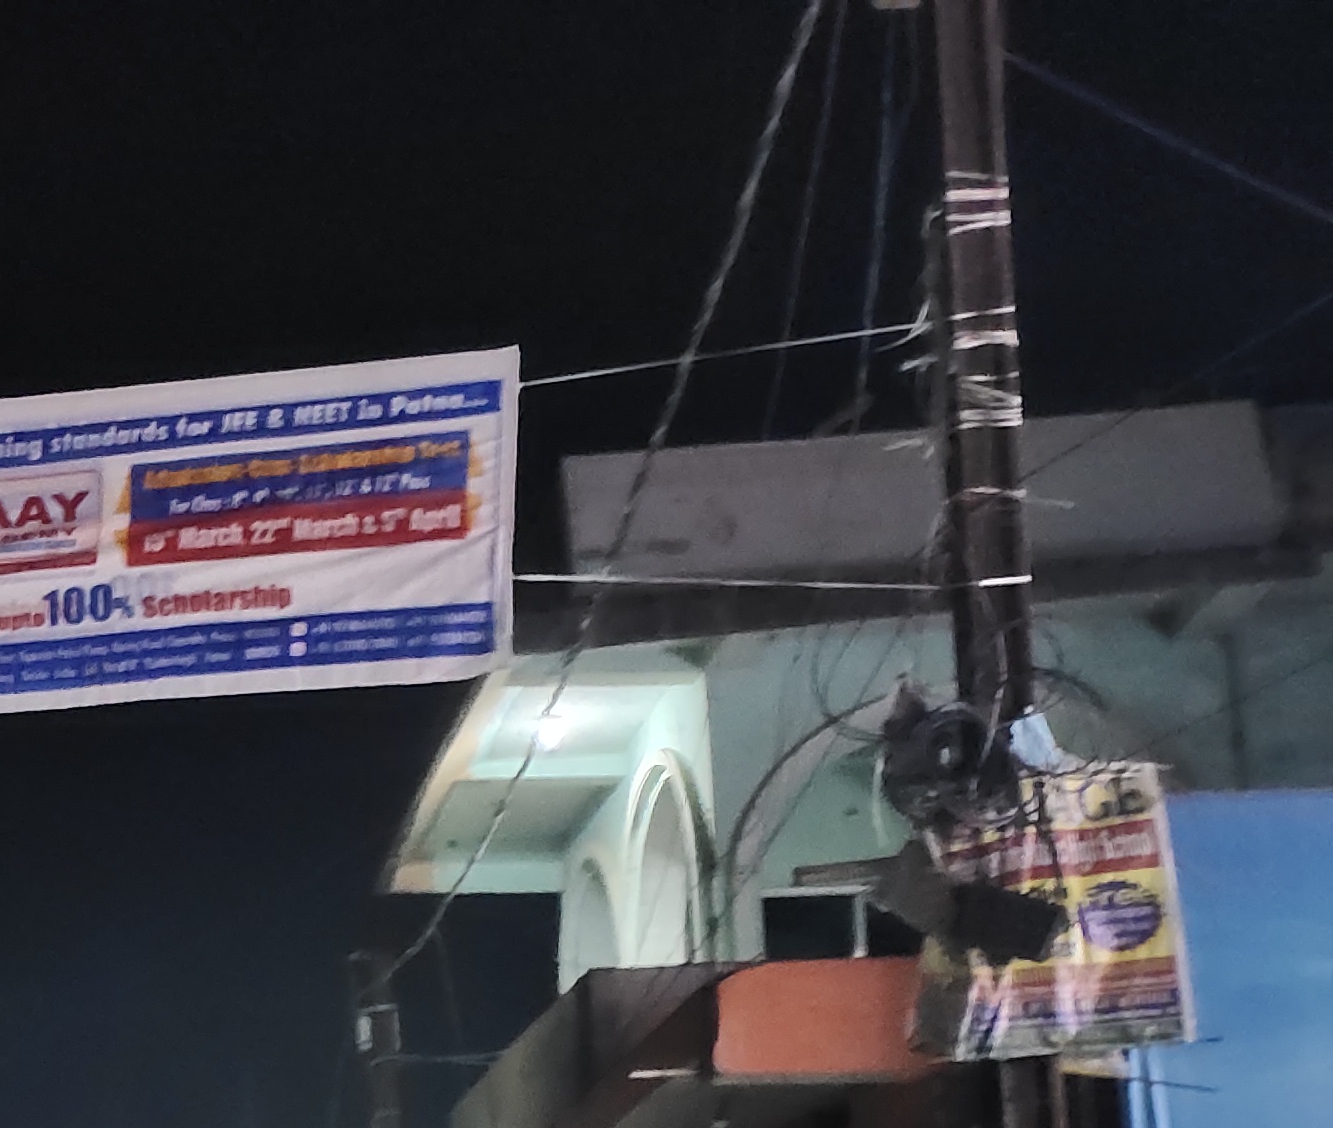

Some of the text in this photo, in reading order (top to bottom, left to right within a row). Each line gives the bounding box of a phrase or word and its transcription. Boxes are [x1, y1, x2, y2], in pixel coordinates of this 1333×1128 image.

[51, 421, 169, 453] standards
[176, 416, 213, 438] for
[221, 410, 258, 433] JEE
[294, 401, 352, 426] NEET
[357, 398, 383, 420] in
[293, 512, 358, 541] March
[409, 502, 461, 532] April
[142, 584, 291, 619] Scholarship
